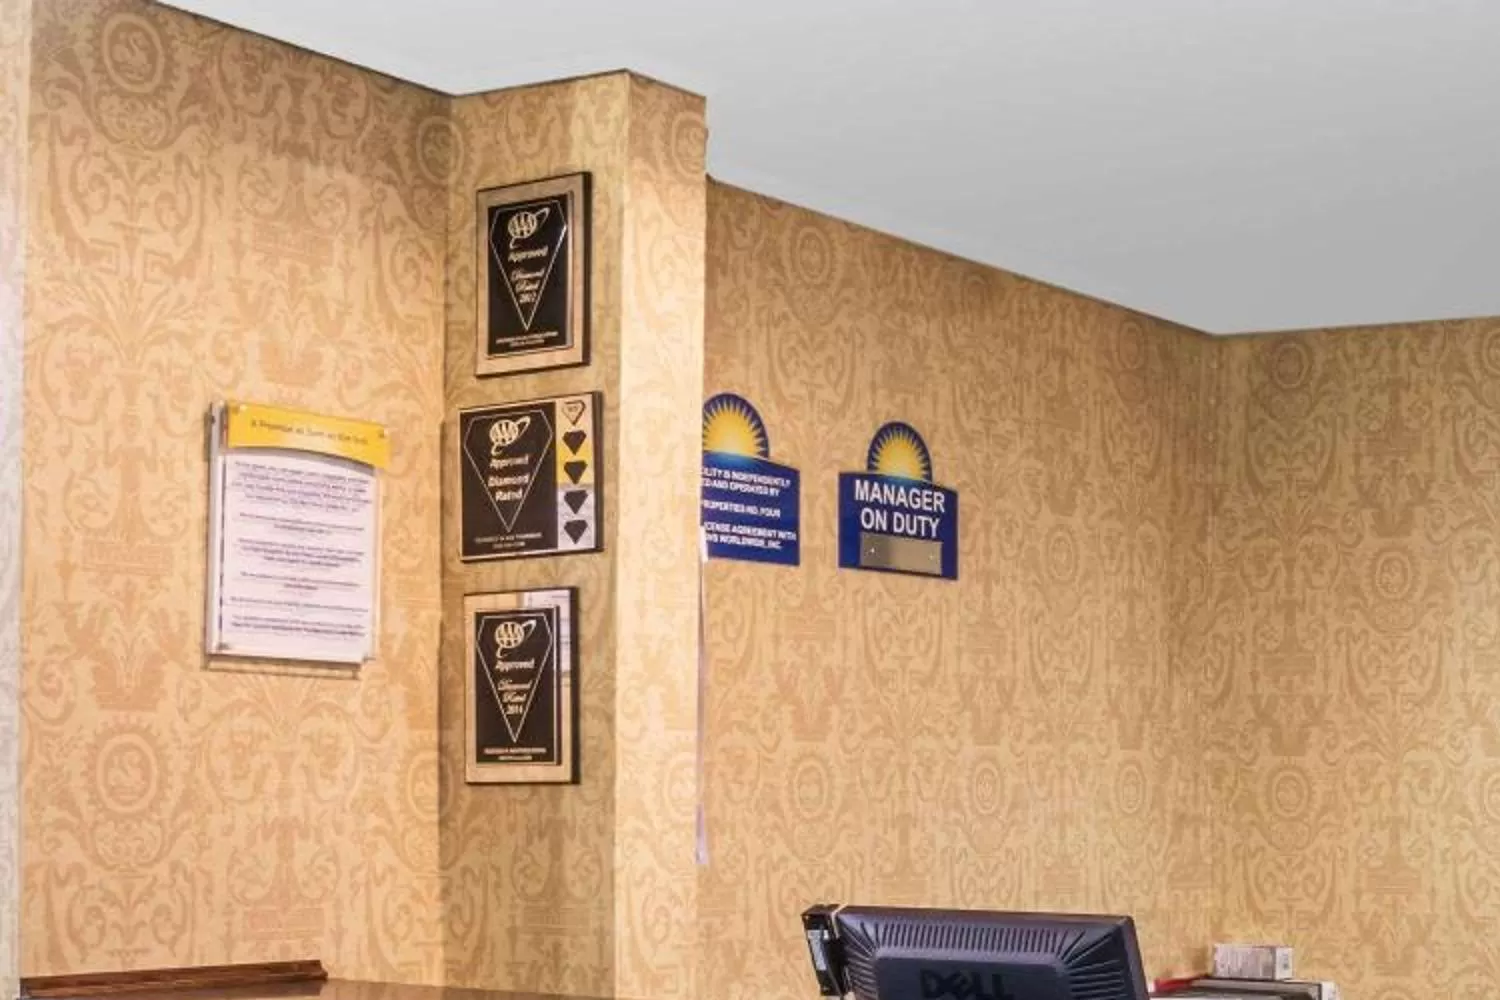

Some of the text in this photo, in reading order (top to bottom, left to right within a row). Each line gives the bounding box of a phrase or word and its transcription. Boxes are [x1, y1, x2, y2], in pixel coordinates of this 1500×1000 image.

[488, 474, 530, 487] Diamond
[713, 480, 729, 489] AND
[730, 481, 769, 495] OPERATED
[769, 487, 780, 497] BY
[854, 479, 946, 513] MANAGER
[860, 507, 940, 538] ON DUTY
[732, 525, 777, 538] AGREEMENT
[777, 531, 797, 541] WITH
[495, 658, 535, 673] Approved
